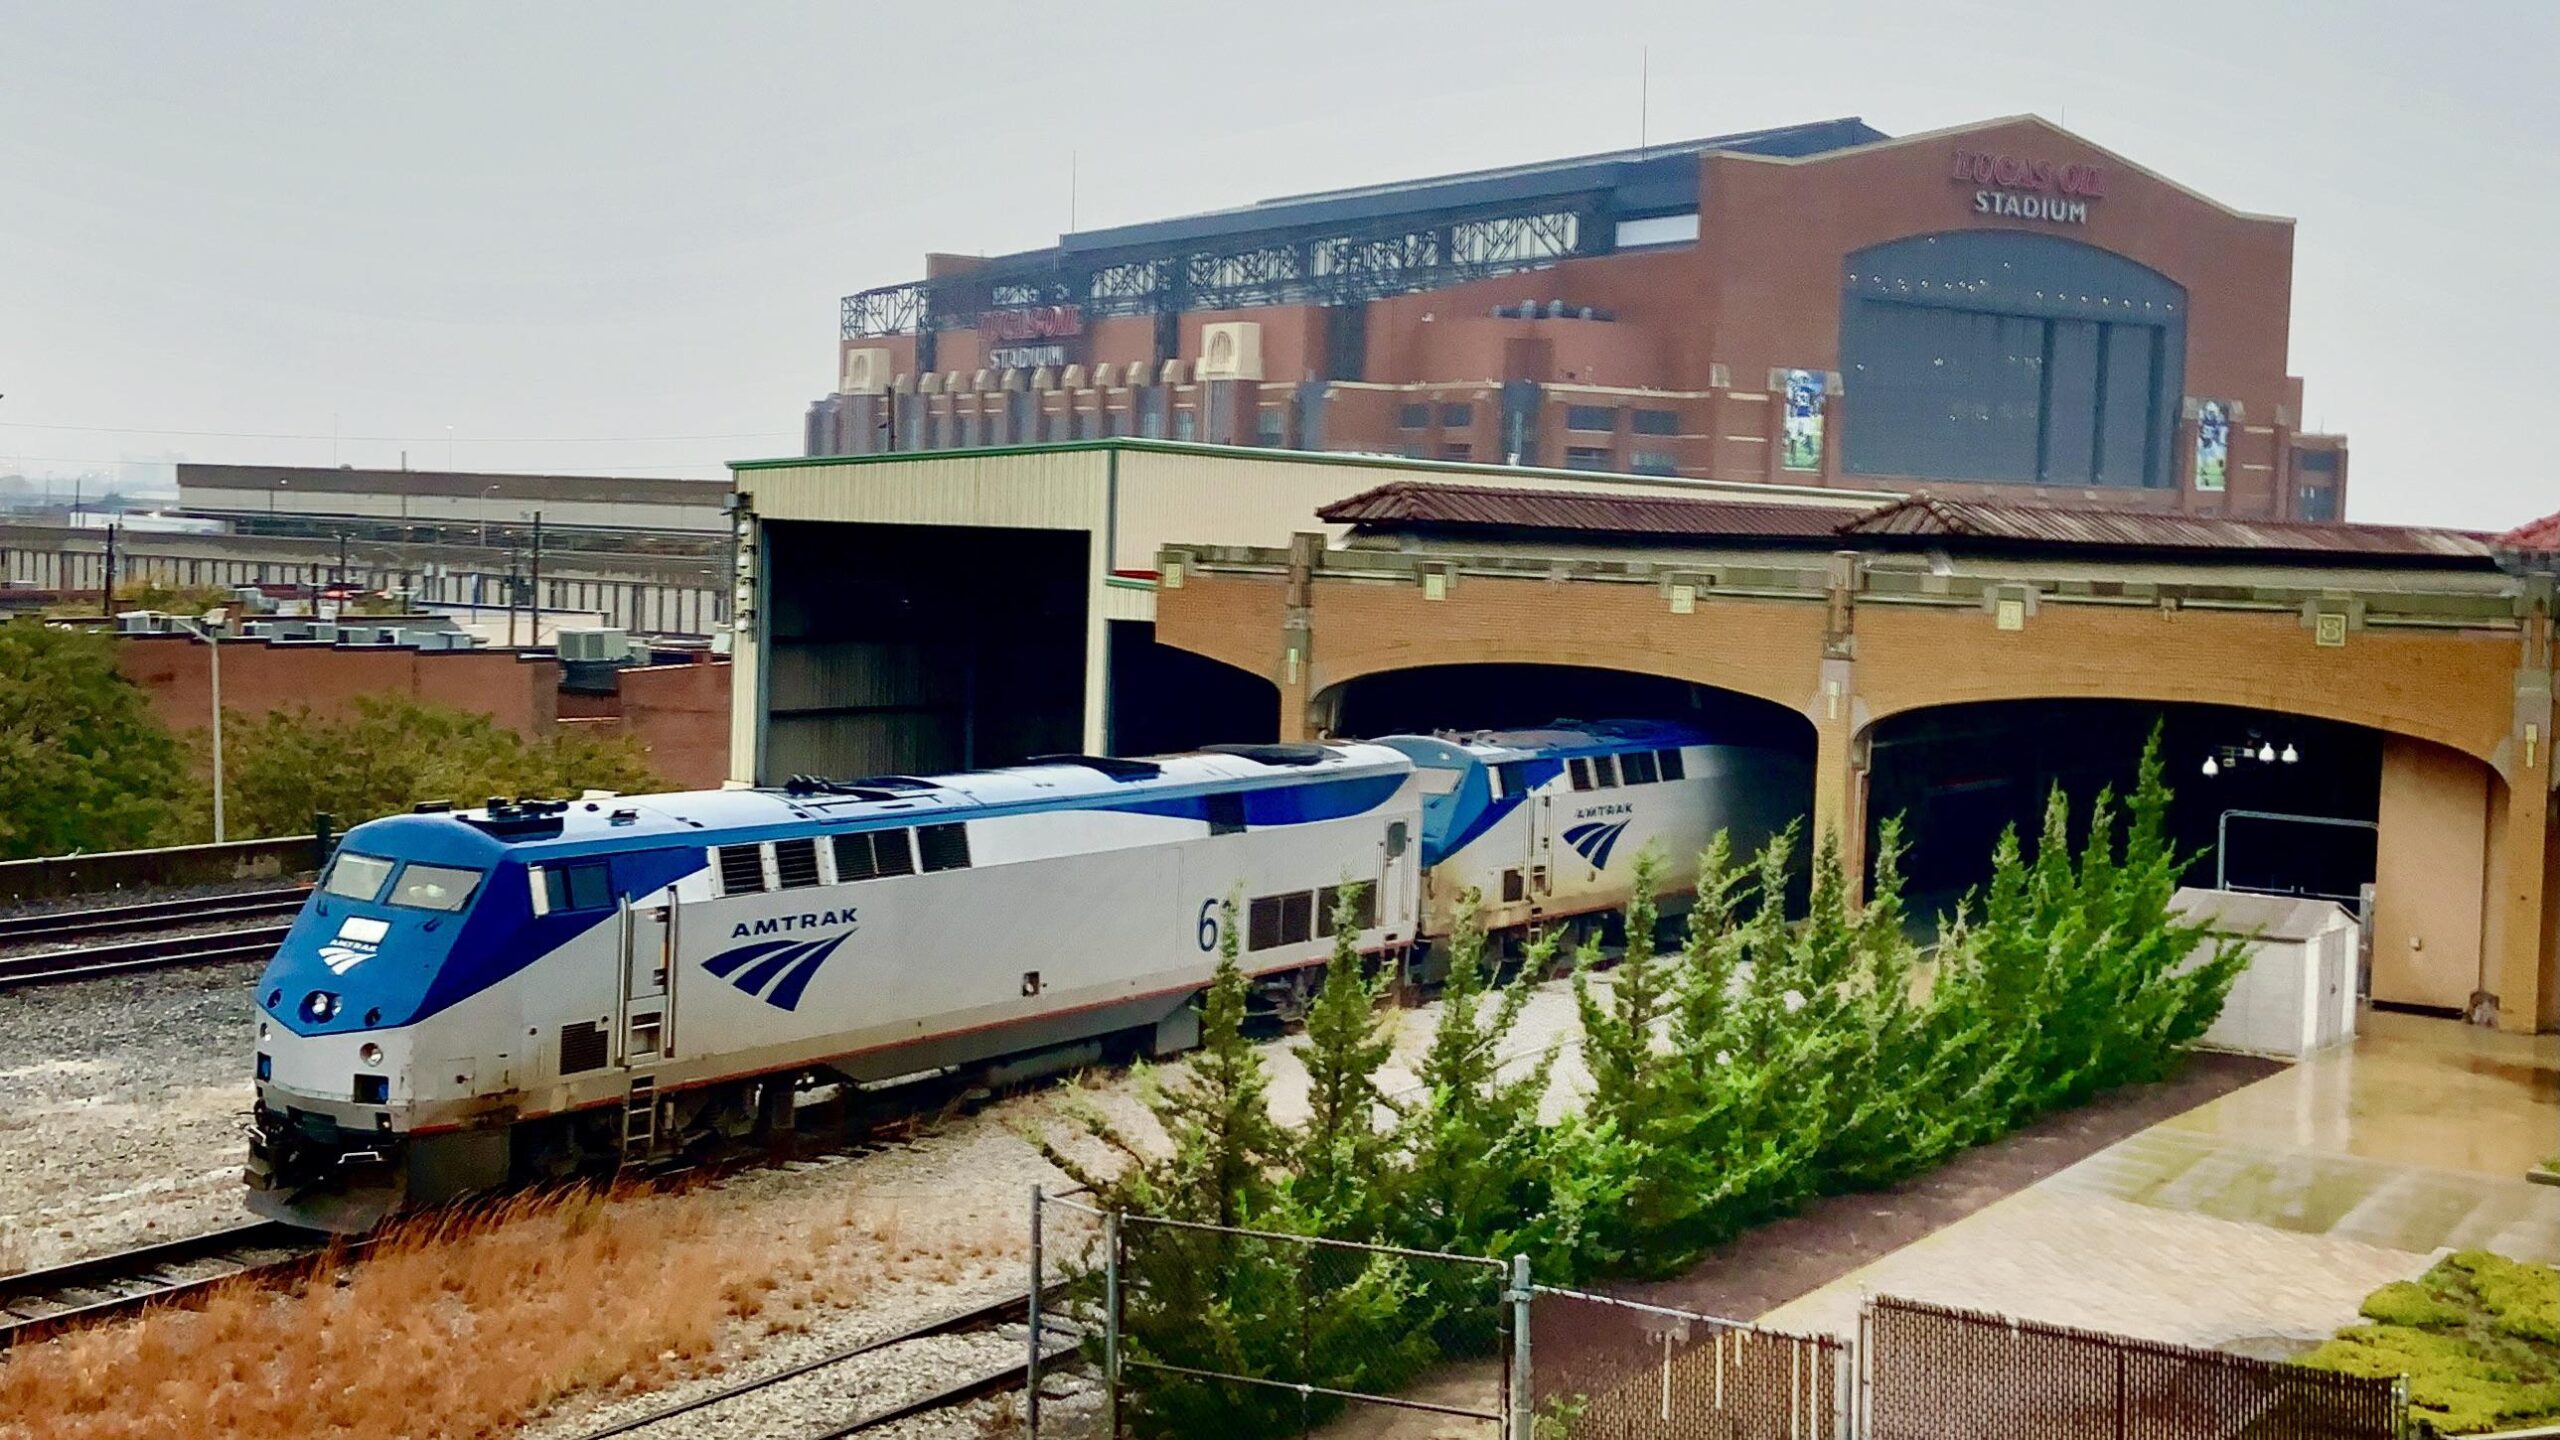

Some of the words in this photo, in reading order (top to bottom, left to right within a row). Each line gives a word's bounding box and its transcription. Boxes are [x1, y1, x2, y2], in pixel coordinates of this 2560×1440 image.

[1952, 150, 2051, 190] LUCAS
[1975, 190, 2088, 225] STADIUM
[990, 345, 1064, 369] STADIUM
[1575, 803, 1633, 819] AMTRAK
[731, 907, 858, 939] AMTRAK
[1199, 898, 1232, 952] 6
